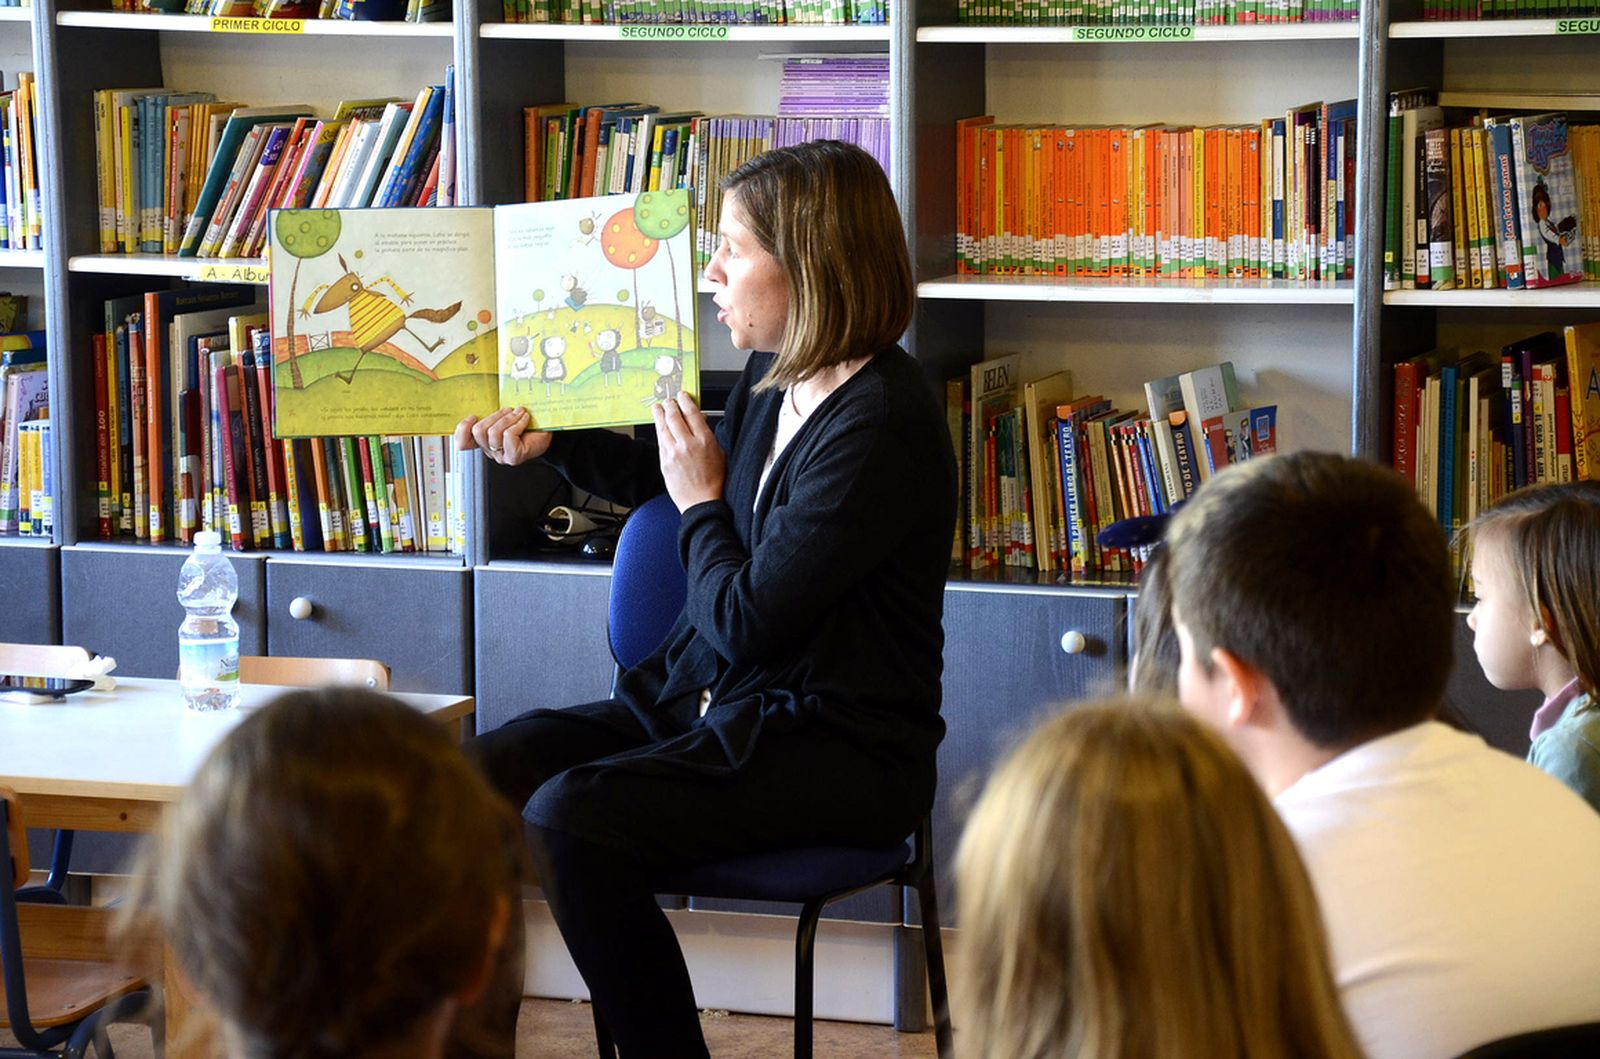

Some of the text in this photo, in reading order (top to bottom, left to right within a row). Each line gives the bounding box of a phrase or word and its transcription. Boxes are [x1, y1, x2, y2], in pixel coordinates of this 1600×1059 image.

[213, 19, 300, 31] PRIMER CICLO
[1558, 20, 1600, 32] SEGU
[621, 27, 727, 38] SEGUNDO CICLO
[1077, 27, 1191, 39] SEGUNDO CICLO
[206, 267, 217, 279] A
[1062, 426, 1072, 460] TEATRO
[1175, 432, 1188, 466] TEATRO
[1065, 463, 1074, 474] DE
[1182, 468, 1191, 479] DE
[1066, 475, 1076, 499] LIBRO
